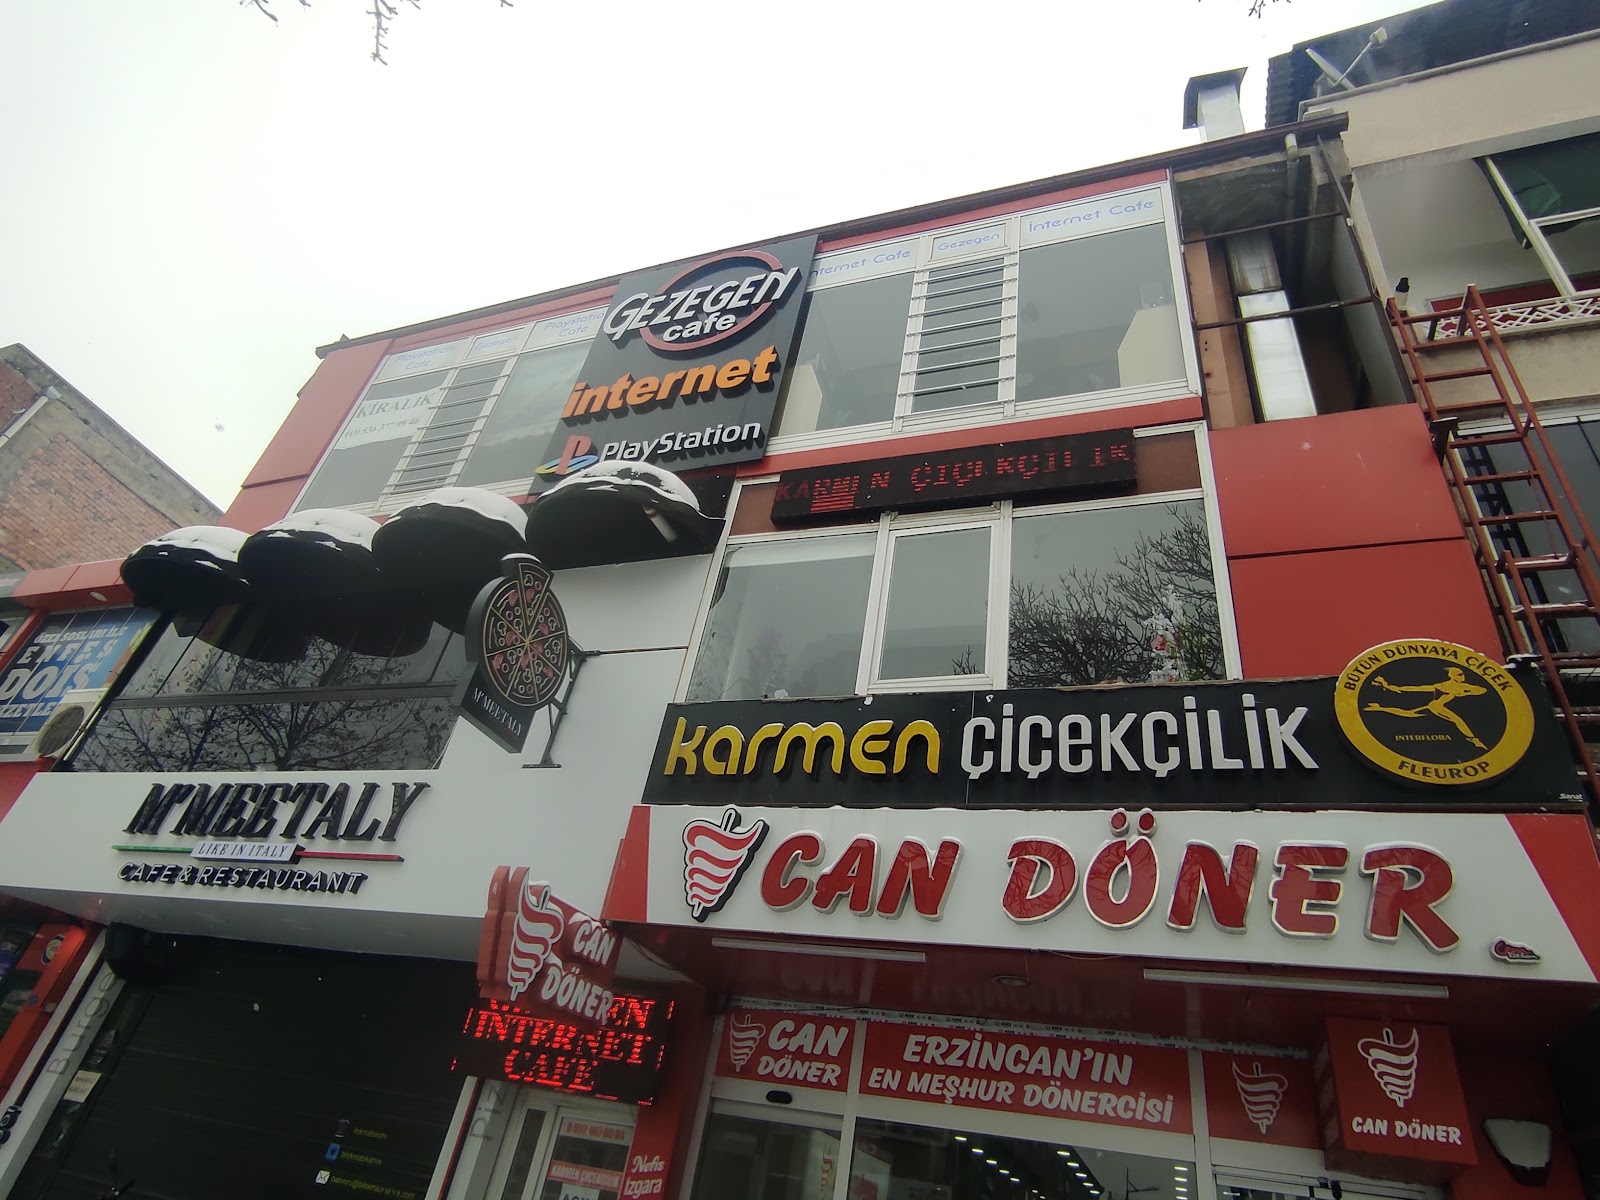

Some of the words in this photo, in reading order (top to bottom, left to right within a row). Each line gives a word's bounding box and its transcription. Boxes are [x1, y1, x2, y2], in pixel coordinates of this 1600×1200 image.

[1109, 200, 1155, 216] Cafe
[938, 232, 1001, 252] Gezegen
[808, 257, 867, 279] nternet
[872, 249, 912, 264] Cafe
[603, 266, 800, 341] GEZEGEN
[544, 312, 604, 332] Playstatio
[557, 324, 588, 339] Cafe
[662, 312, 736, 342] cafe
[561, 345, 778, 419] internet
[354, 391, 436, 419] KİRALIK
[601, 421, 761, 463] PlayStation
[1343, 654, 1381, 692] BÜTÜN
[1383, 643, 1459, 661] DÜNYAYA
[1465, 656, 1514, 692] ÇİÇEK
[1395, 734, 1452, 742] INTERFLORA
[1398, 759, 1490, 780] FLEUROP
[197, 842, 229, 856] LIKE
[230, 844, 248, 857] IN
[247, 844, 290, 858] ITALY
[197, 867, 366, 894] RESTAURANT
[759, 828, 964, 921] CAN
[1000, 808, 1464, 956] DÖNER
[573, 920, 617, 966] CAN
[541, 967, 615, 1026] DÖNER
[47, 971, 117, 1076] Burge
[767, 1018, 850, 1057] CAN
[756, 1054, 843, 1087] DÖNER
[903, 1032, 1134, 1087] ERZİNCAN'IN
[867, 1066, 903, 1091] EN
[906, 1073, 1016, 1105] MEŞHUR
[1023, 1080, 1175, 1125] DÖNERCİSİ
[1351, 1116, 1388, 1136] CAN
[1394, 1119, 1462, 1146] DÖNER
[631, 1154, 666, 1174] Nefis
